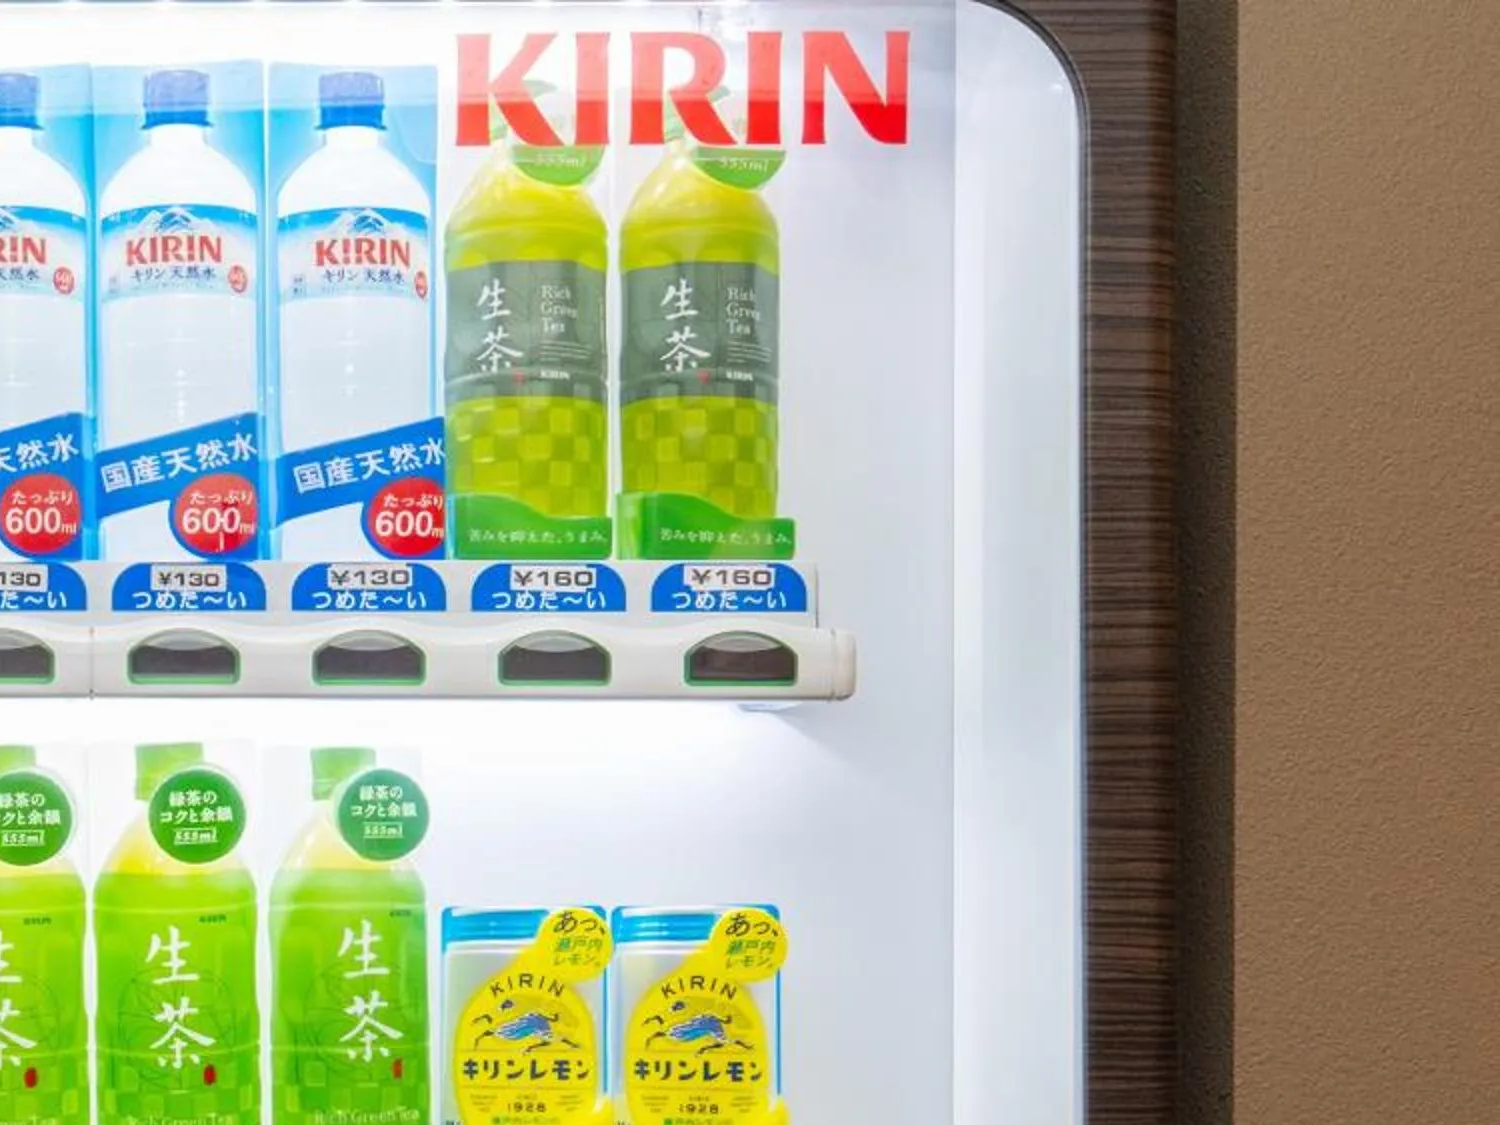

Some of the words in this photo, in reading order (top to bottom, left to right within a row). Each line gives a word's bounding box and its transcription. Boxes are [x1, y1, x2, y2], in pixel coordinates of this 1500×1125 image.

[455, 31, 910, 147] KIRIN
[126, 235, 222, 267] KIRIN
[315, 237, 411, 268] KIRIN
[100, 432, 258, 493] 国産天然水
[293, 437, 446, 493] 国産天然水
[11, 490, 74, 505] たっぷり
[190, 490, 253, 505] たっぷり
[383, 493, 443, 508] たっぷり
[4, 507, 77, 535] 600ml
[158, 571, 220, 588] ¥130
[331, 568, 410, 586] ¥130
[514, 570, 595, 587] ¥160
[690, 569, 772, 586] ¥160
[145, 925, 216, 1070] 生茶
[337, 917, 404, 1063] 生茶
[489, 972, 566, 998] KIRIN
[662, 975, 738, 1001] KIRIN
[462, 1059, 590, 1081] キリンレモン
[633, 1060, 762, 1082] キリンレモン
